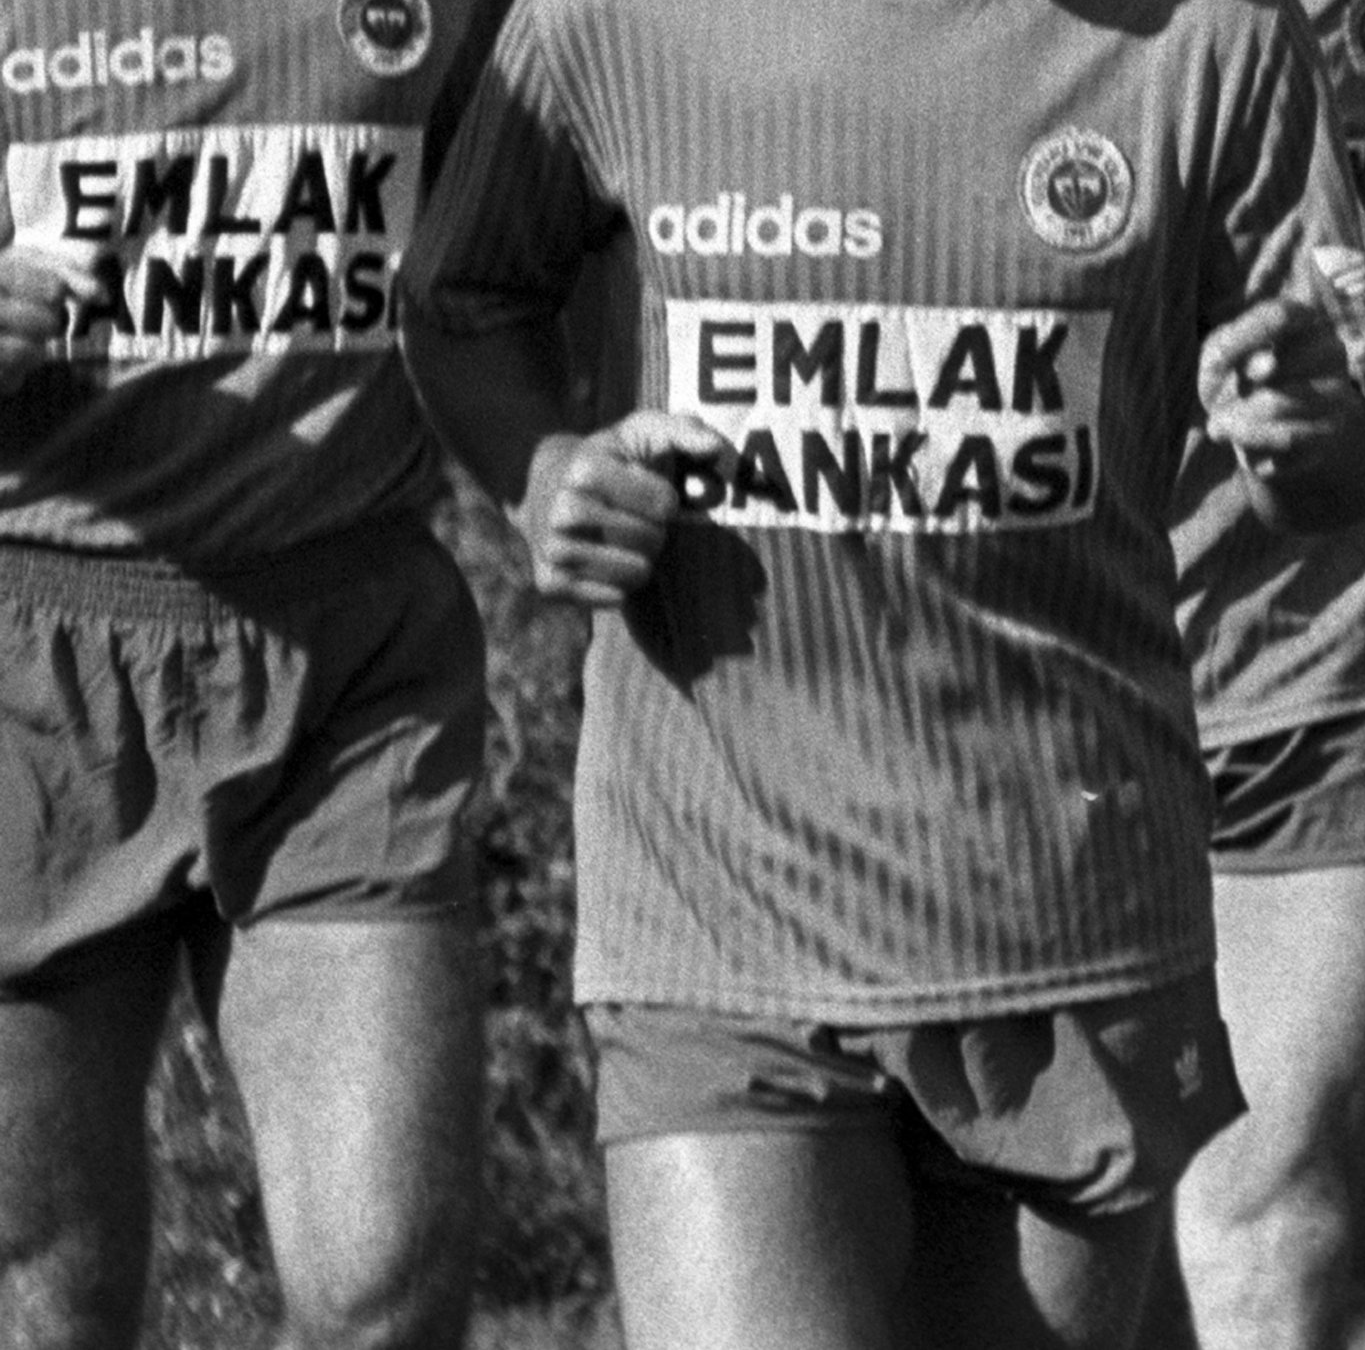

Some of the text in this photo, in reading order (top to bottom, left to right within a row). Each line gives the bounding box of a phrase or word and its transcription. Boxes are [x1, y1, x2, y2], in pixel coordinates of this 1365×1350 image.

[1, 27, 236, 94] adidas
[60, 151, 394, 239] EMLAK
[648, 191, 883, 258] adidas
[699, 319, 1070, 414] EMLAK
